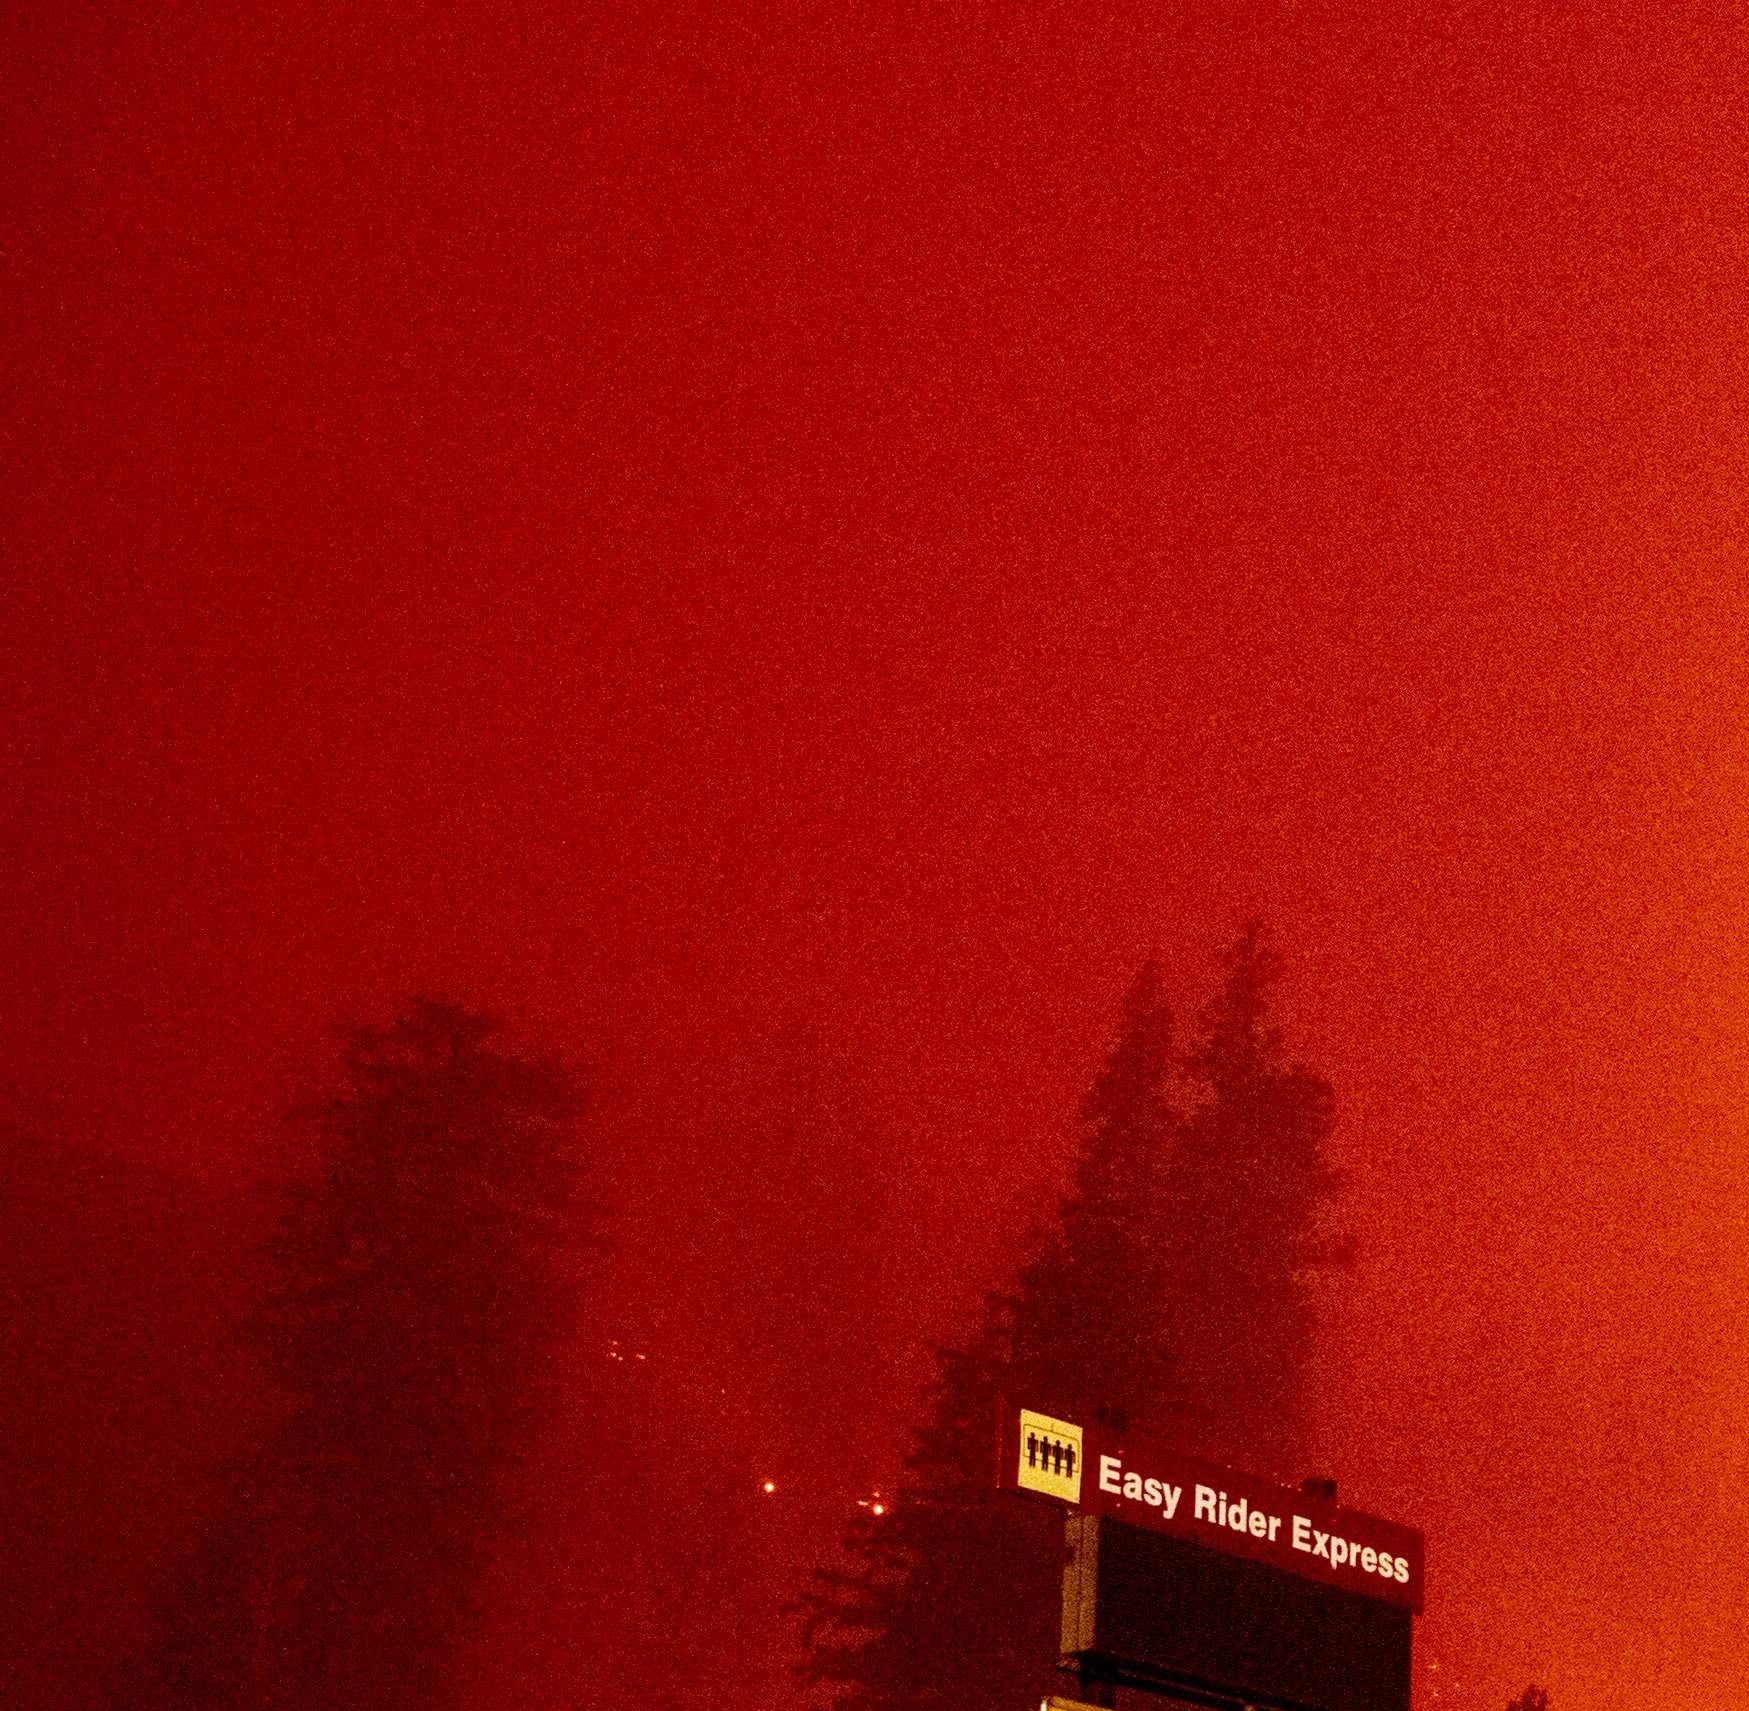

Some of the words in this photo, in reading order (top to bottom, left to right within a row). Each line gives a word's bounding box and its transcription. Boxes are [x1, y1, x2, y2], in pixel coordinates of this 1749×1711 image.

[1099, 1454, 1182, 1519] Easy
[1194, 1483, 1281, 1542] Rider
[1292, 1514, 1410, 1584] Express
